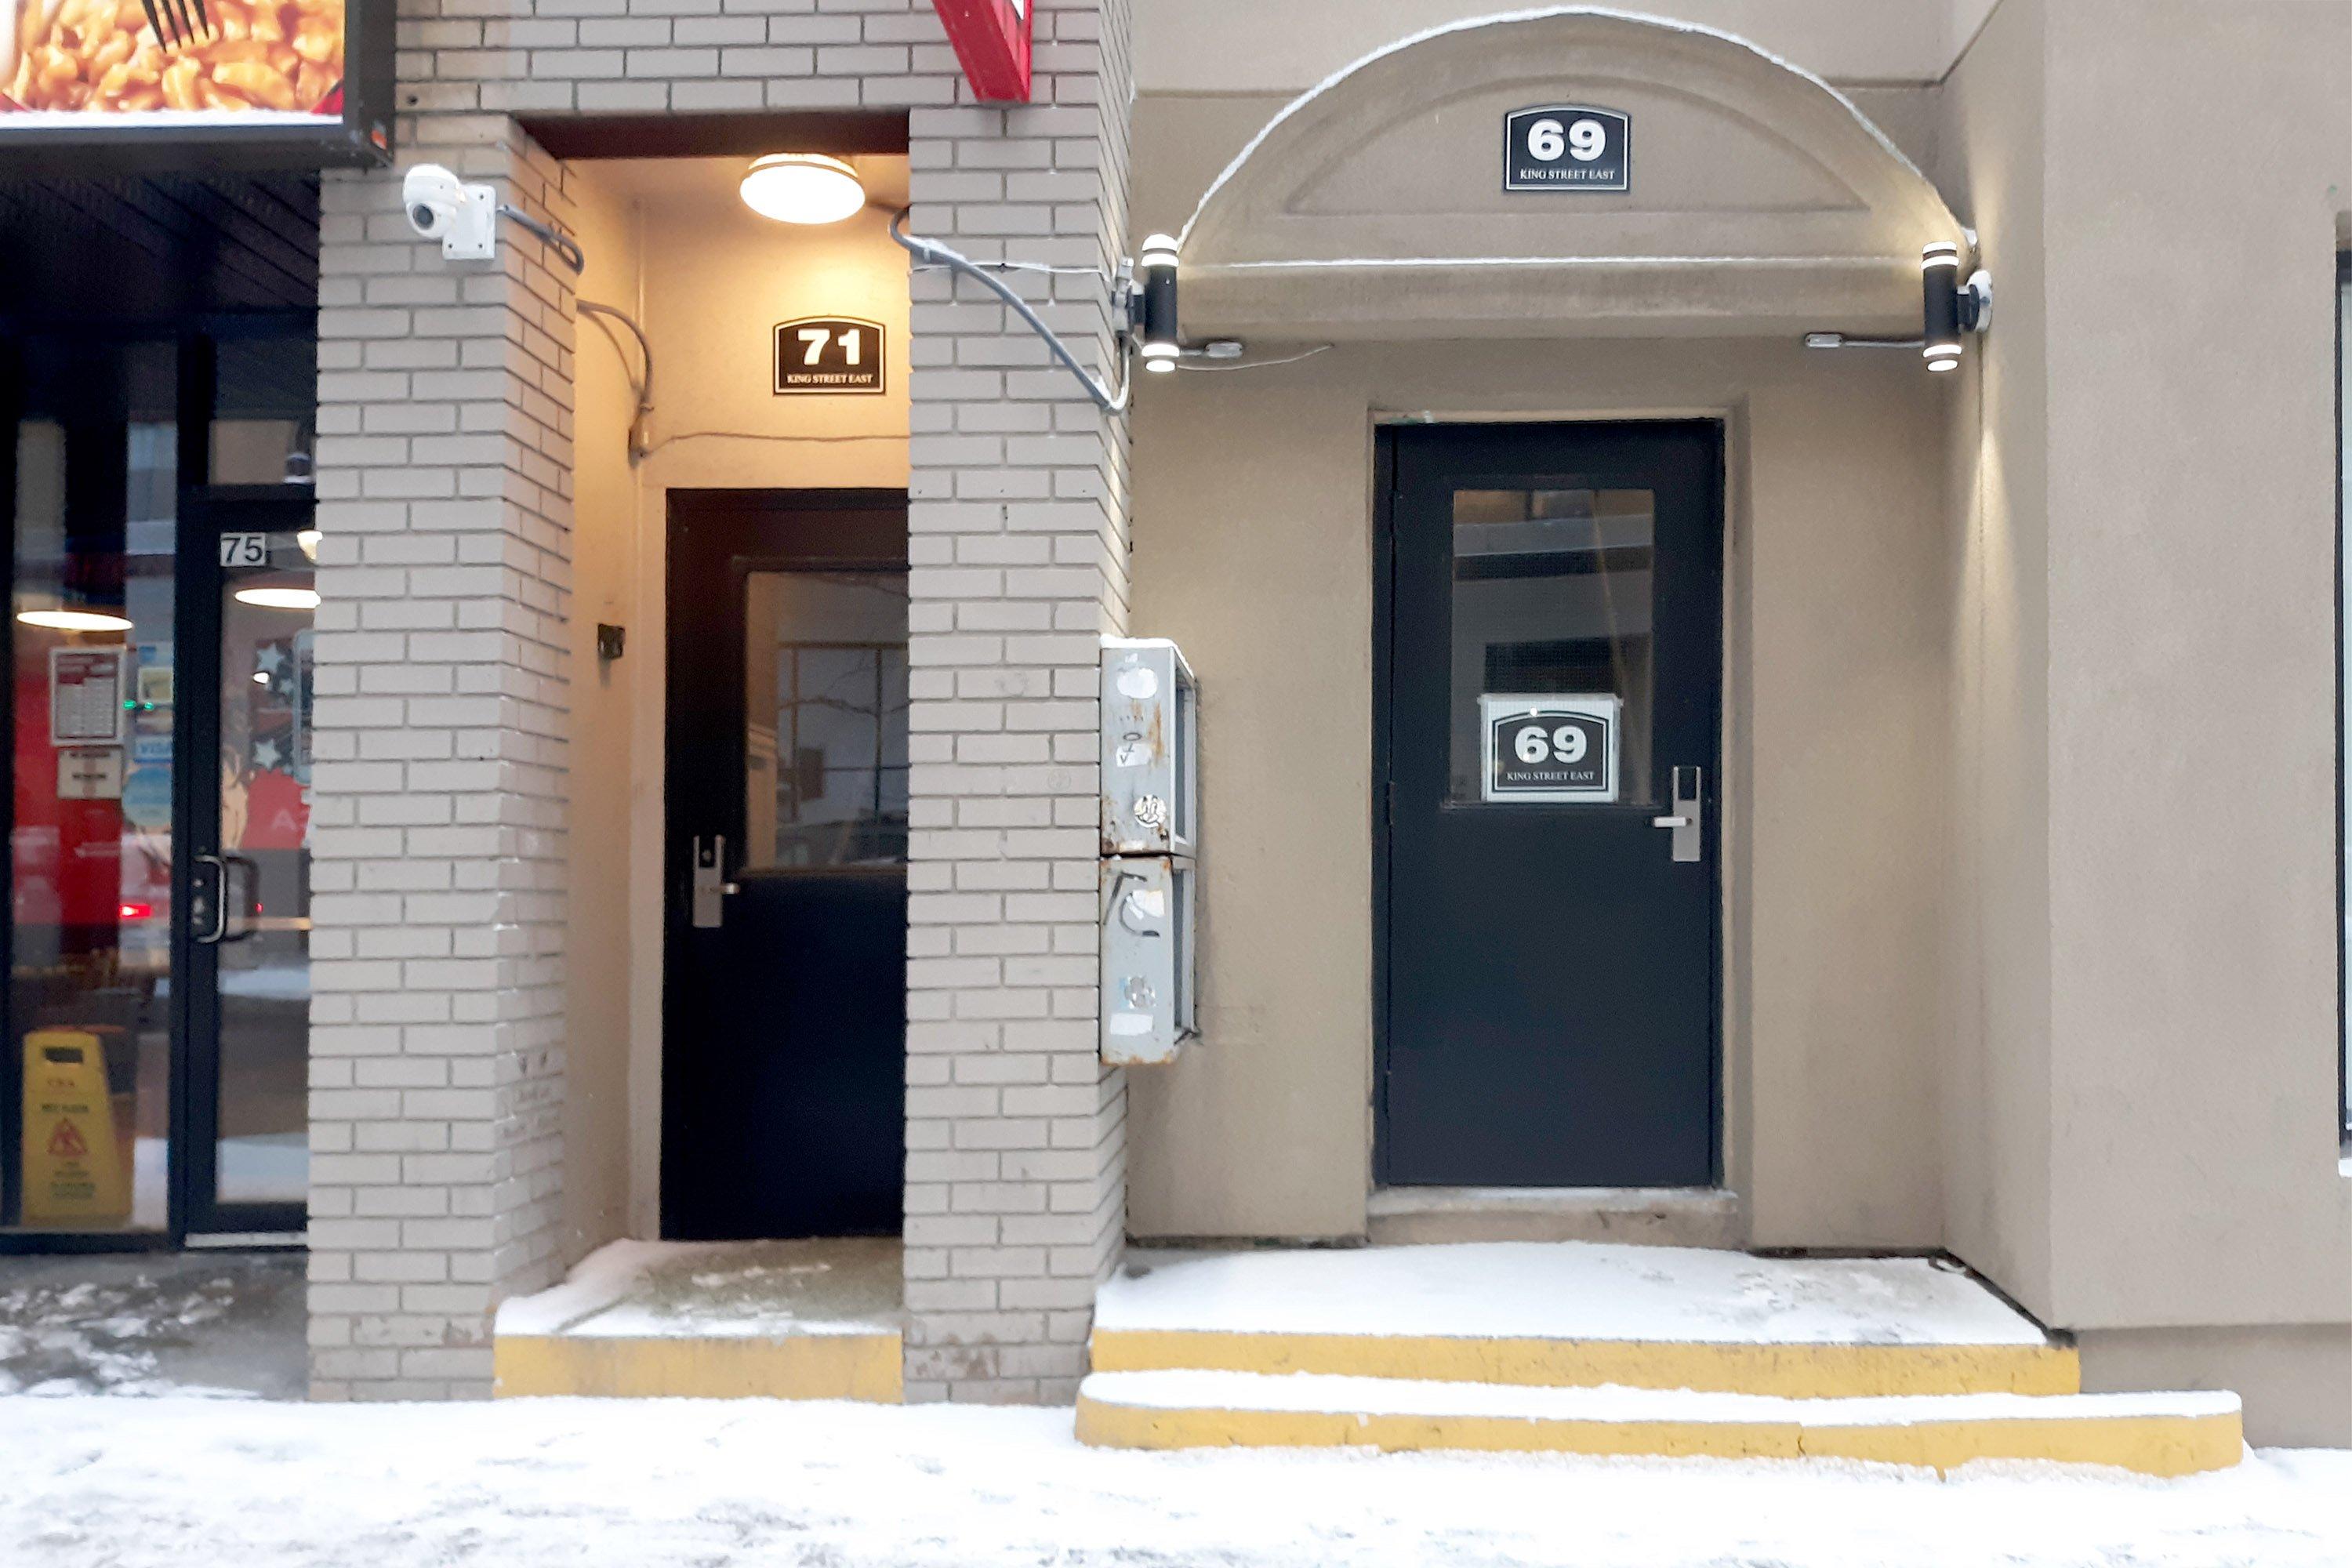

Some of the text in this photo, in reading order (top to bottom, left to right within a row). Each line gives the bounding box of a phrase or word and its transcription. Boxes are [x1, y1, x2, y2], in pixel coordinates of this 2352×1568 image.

[1528, 118, 1606, 161] 69
[1519, 169, 1615, 180] KING STREET EAST
[797, 328, 860, 365] 71
[786, 374, 873, 384] KING STREET EAST
[222, 537, 263, 564] 75
[1515, 725, 1587, 764] 69
[1507, 771, 1595, 781] KING STREET EAST
